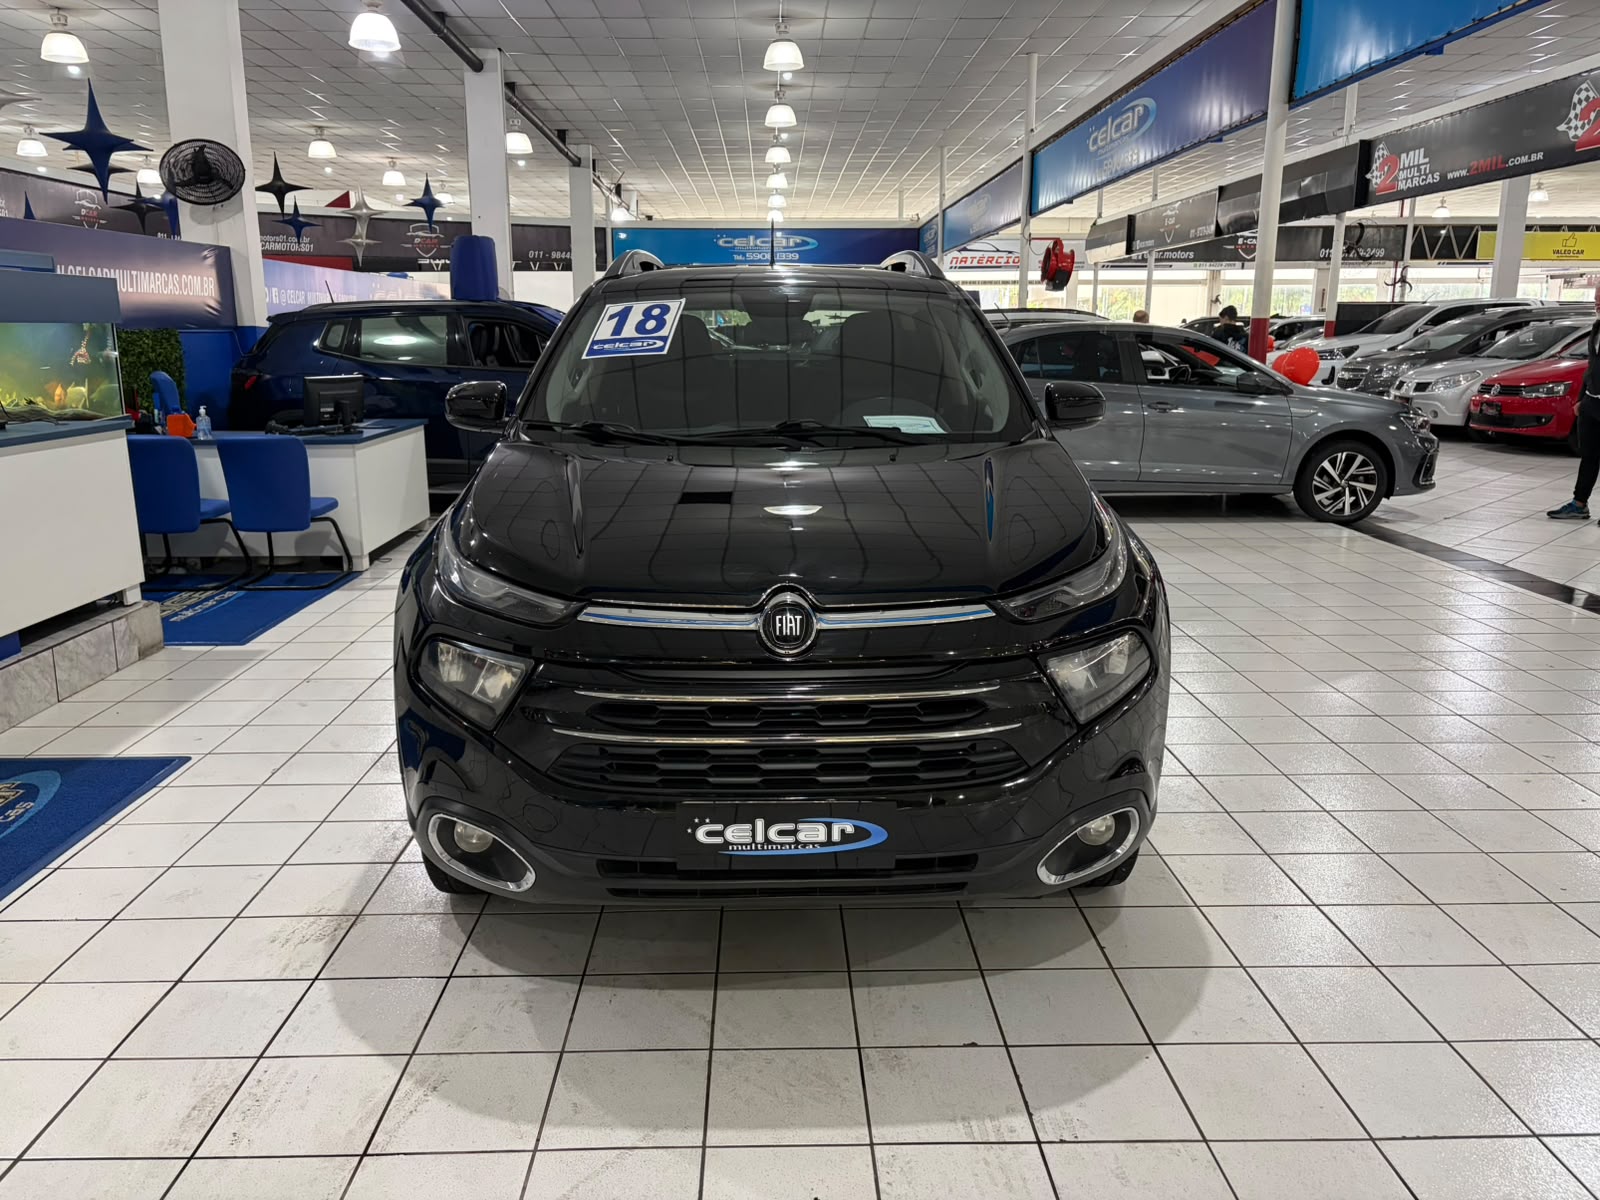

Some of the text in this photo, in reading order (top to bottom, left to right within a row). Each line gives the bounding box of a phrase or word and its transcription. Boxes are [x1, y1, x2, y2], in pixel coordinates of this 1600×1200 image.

[1088, 104, 1145, 152] celcar
[1376, 147, 1429, 196] 2 MIL
[1399, 163, 1430, 180] MULTI
[1397, 172, 1440, 191] MARCAS
[717, 234, 802, 247] celcar
[528, 250, 544, 259] 011
[551, 251, 572, 259] 9844
[607, 303, 672, 337] 18
[593, 341, 656, 350] celcar
[775, 614, 803, 636] FIAT
[694, 818, 856, 844] celcar
[728, 842, 822, 851] multimarcas
